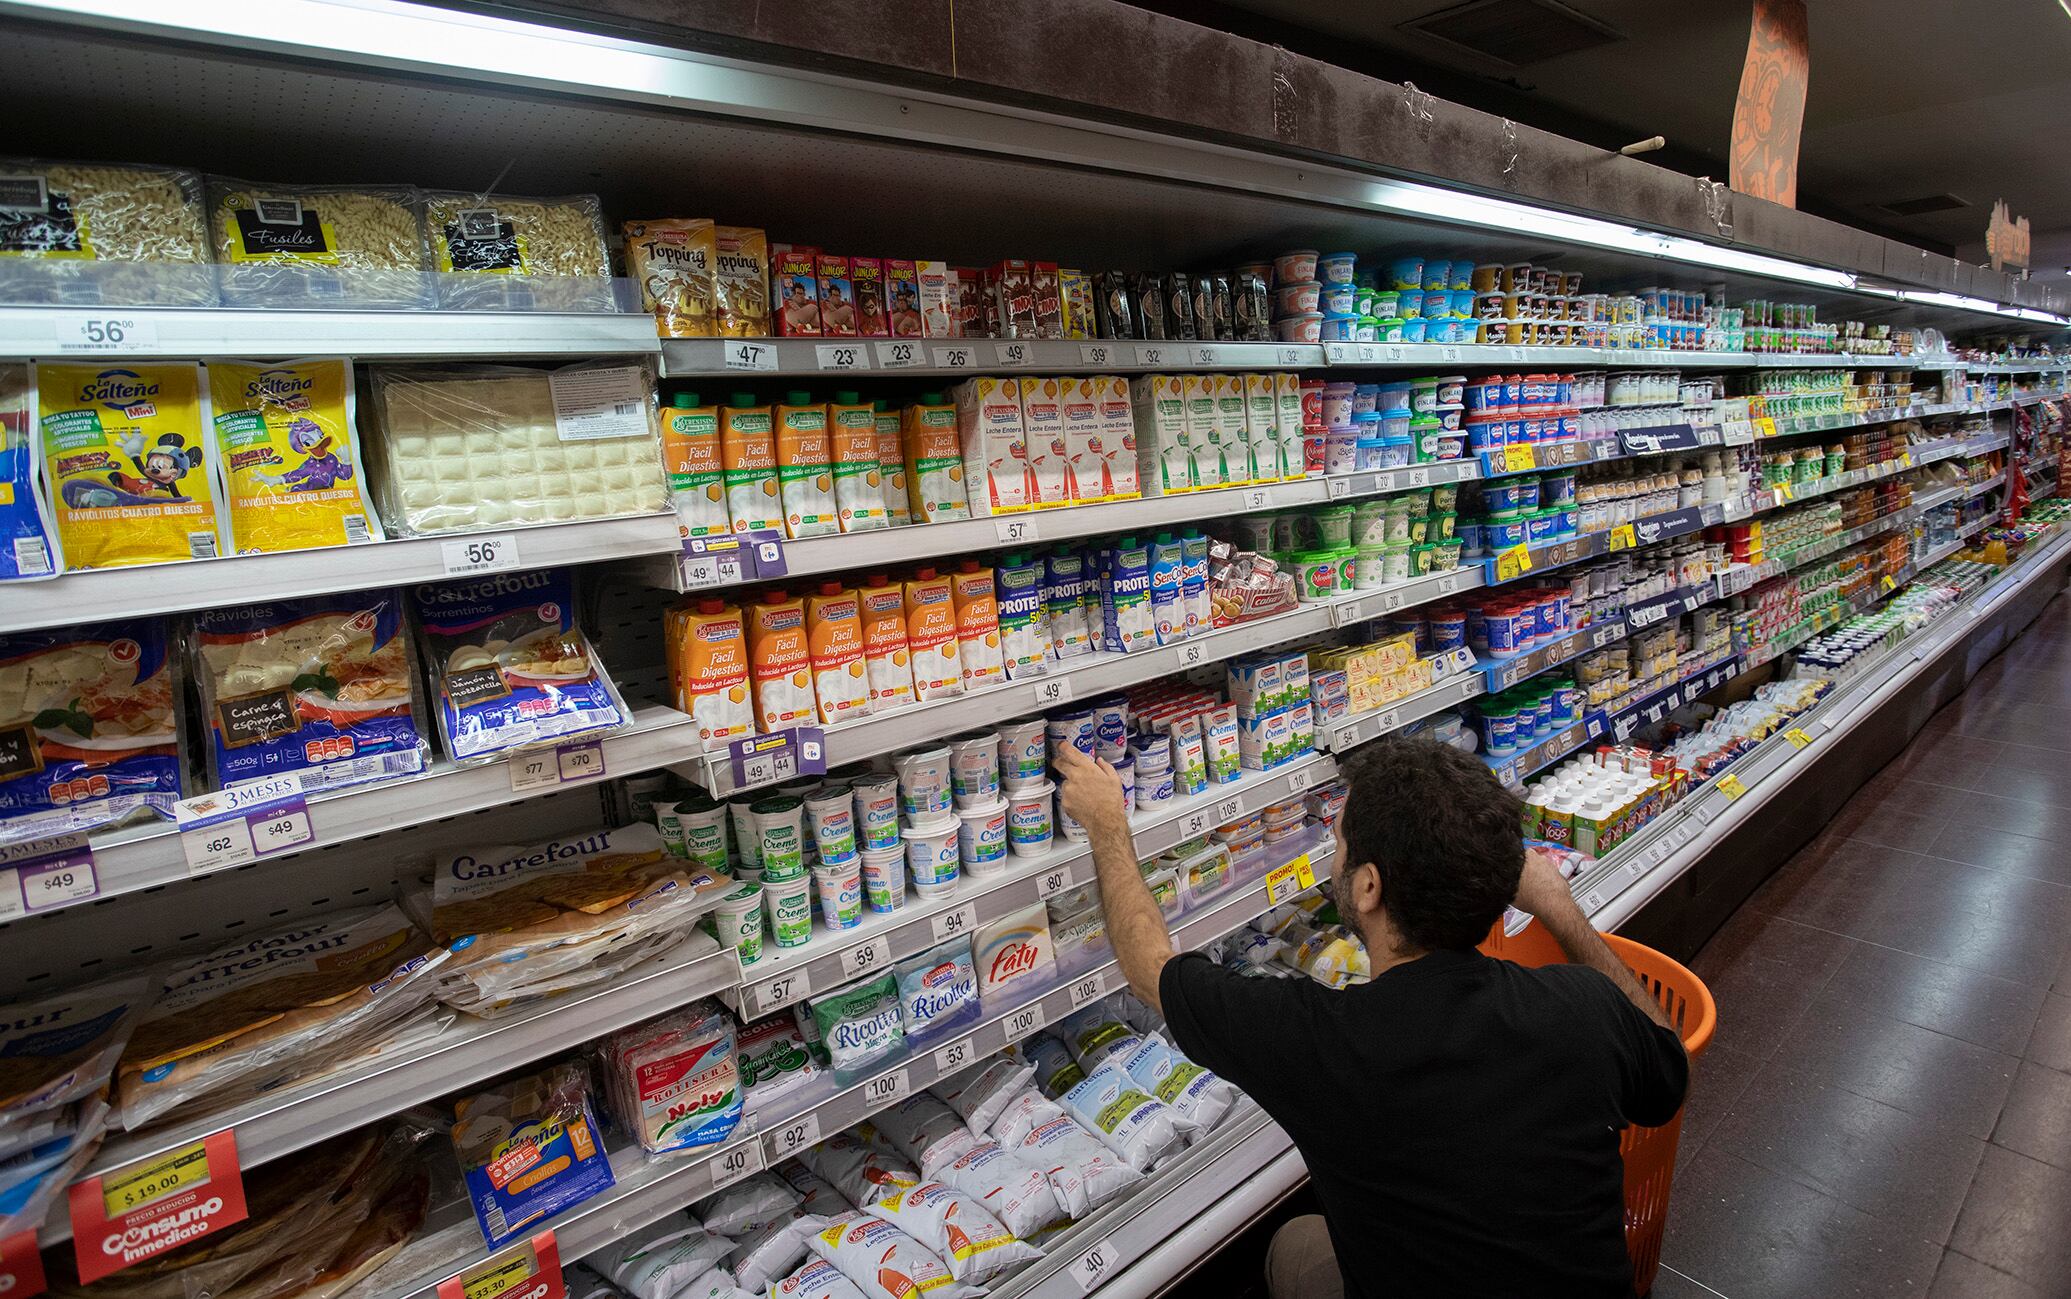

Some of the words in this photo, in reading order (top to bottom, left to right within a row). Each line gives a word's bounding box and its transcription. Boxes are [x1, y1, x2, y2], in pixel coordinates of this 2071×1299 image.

[248, 229, 316, 247] Fusiles
[641, 241, 707, 269] Topping
[97, 379, 110, 387] La
[80, 382, 160, 403] Salteña
[127, 406, 154, 418] Mini
[688, 446, 712, 460] Fácil
[746, 443, 769, 457] Fácil
[800, 440, 822, 453] Fácil
[321, 488, 354, 500] QUESOS
[68, 508, 120, 522] RAVIOLITOS
[121, 506, 161, 518] CUATRO
[164, 503, 203, 515] QUESOS
[415, 570, 550, 605] Carrefour
[204, 605, 274, 623] Ravioles
[422, 604, 494, 618] Sorrentinos
[971, 602, 990, 616] Fácil
[877, 618, 898, 633] Fácil
[926, 611, 946, 625] Fácil
[775, 637, 798, 653] Fácil
[832, 629, 853, 644] Fácil
[710, 649, 735, 666] Fácil
[767, 649, 807, 665] Digestión
[701, 663, 744, 679] Digestión
[451, 681, 502, 698] mozzarella
[231, 702, 268, 719] Carne
[232, 711, 286, 731] espinaca
[224, 791, 239, 810] 3
[240, 778, 292, 801] MESES
[1011, 813, 1046, 825] Crema
[268, 820, 293, 837] $49
[1544, 826, 1568, 840] Yogs
[206, 837, 232, 853] $62
[687, 836, 722, 849] Crema
[452, 830, 612, 881] Carrefour
[44, 873, 75, 890] $49
[988, 942, 1039, 984] Faty
[911, 977, 972, 1020] Ricotta
[652, 1063, 730, 1104] ROTISERA
[572, 1126, 591, 1147] 12
[139, 1174, 179, 1200] 19.00
[126, 1208, 155, 1225] PRECIO
[156, 1193, 197, 1213] REDUCIDO
[102, 1196, 223, 1256] Consumo
[123, 1220, 209, 1262] inmediato
